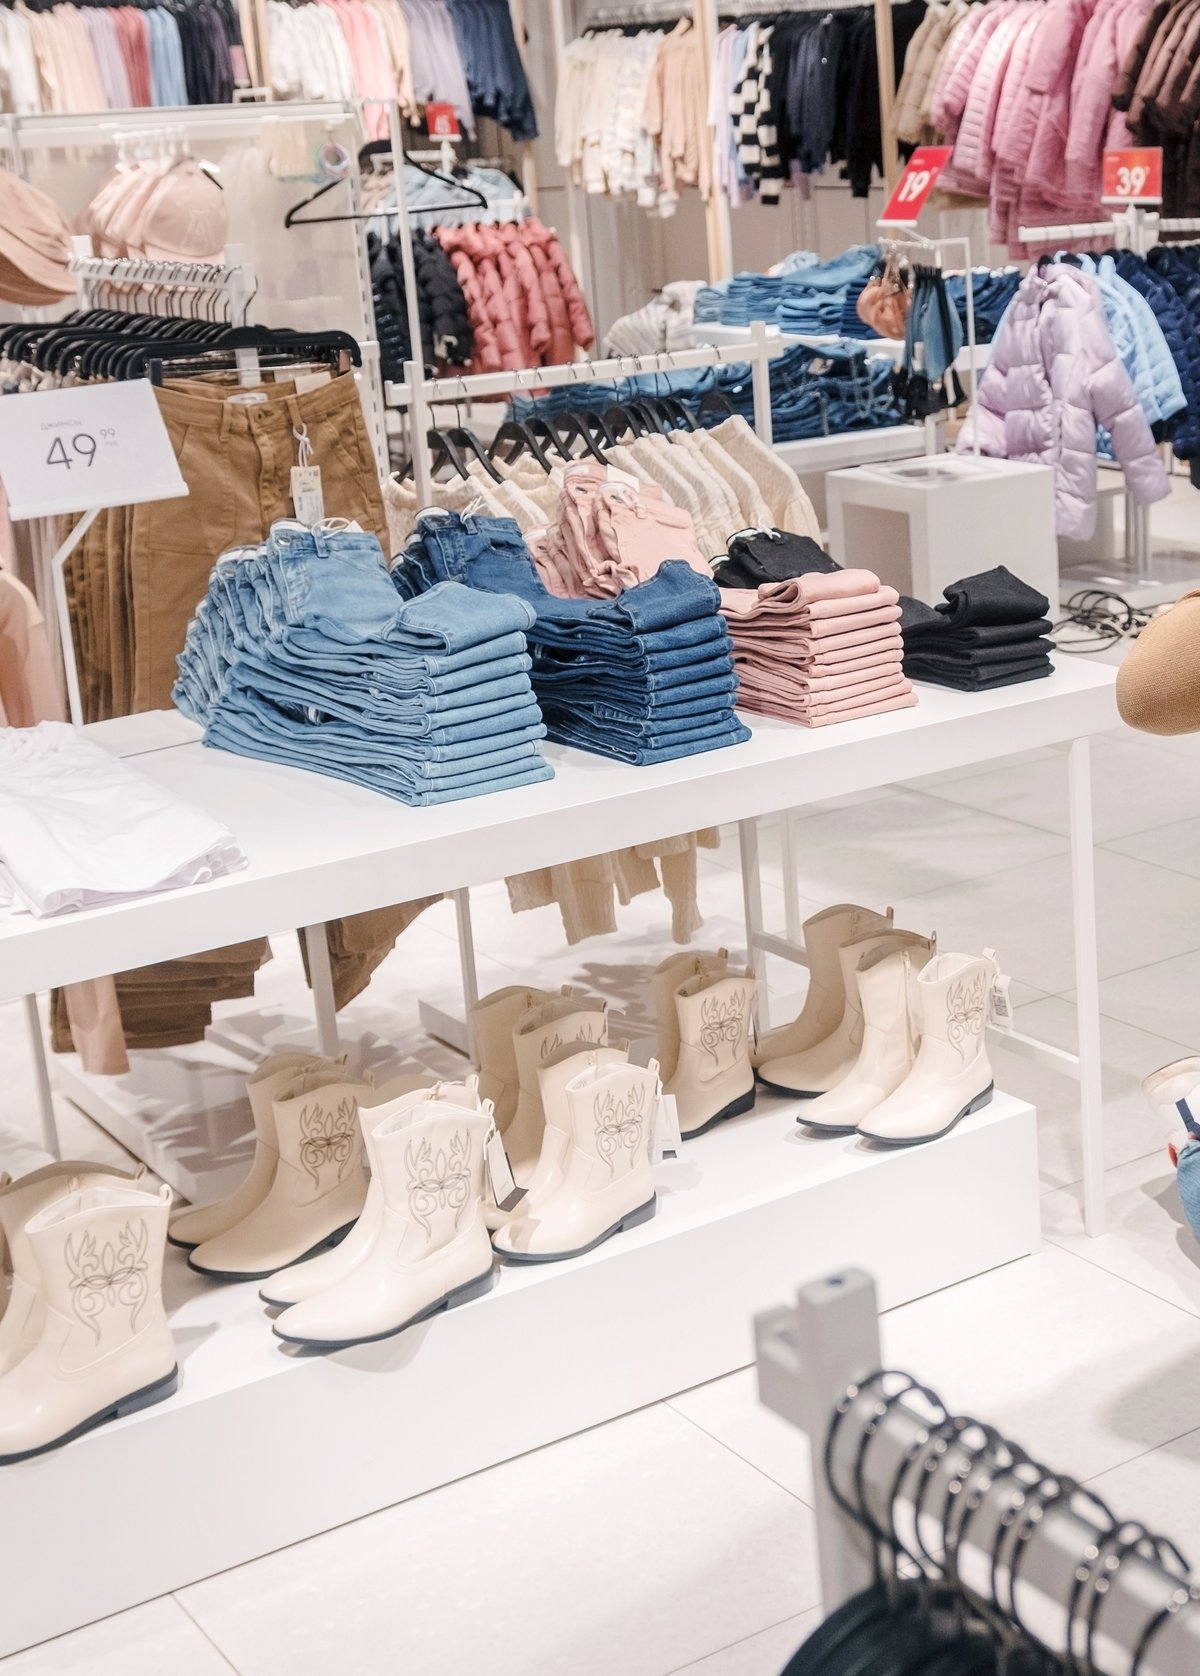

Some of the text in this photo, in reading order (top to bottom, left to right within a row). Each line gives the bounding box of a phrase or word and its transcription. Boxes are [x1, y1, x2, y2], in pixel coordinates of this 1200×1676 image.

[897, 170, 931, 202] 19
[1116, 166, 1146, 195] 39
[46, 427, 116, 470] 49 99
